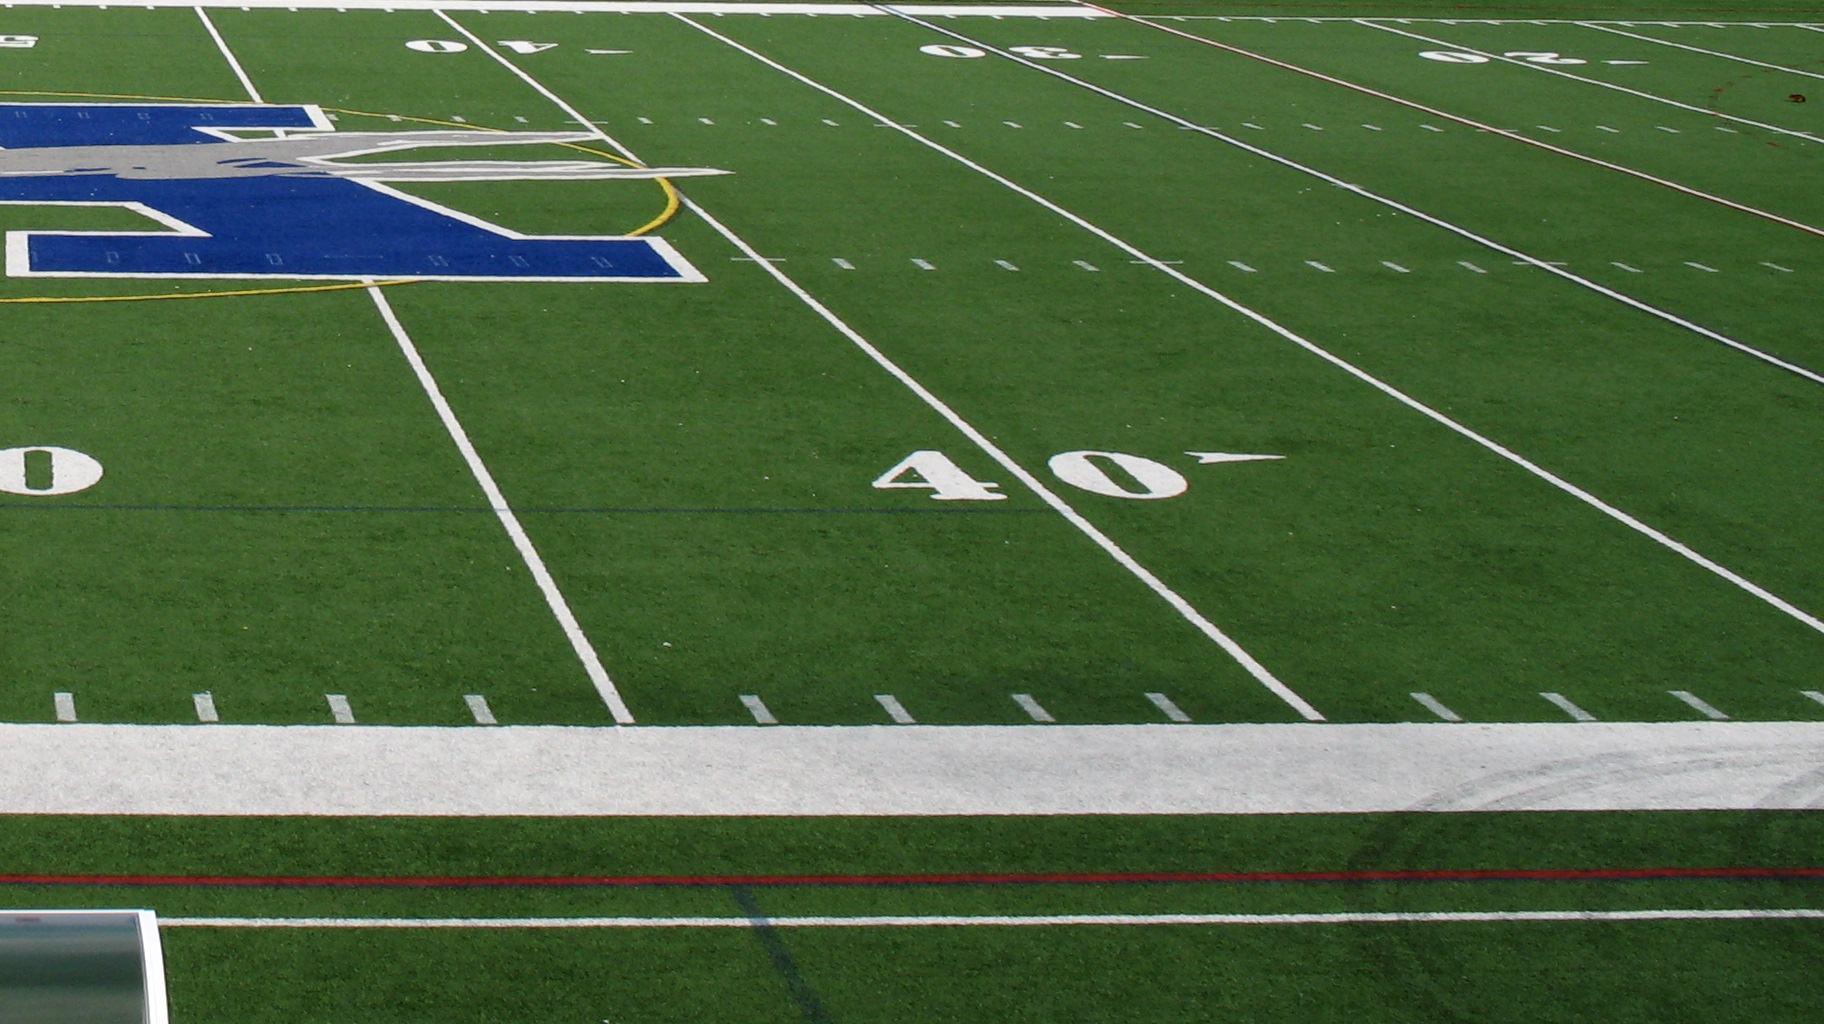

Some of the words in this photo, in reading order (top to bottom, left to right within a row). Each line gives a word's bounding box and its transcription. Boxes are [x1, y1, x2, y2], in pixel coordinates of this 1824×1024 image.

[406, 39, 559, 54] 40
[919, 44, 1082, 59] 30
[872, 450, 1188, 501] 40
